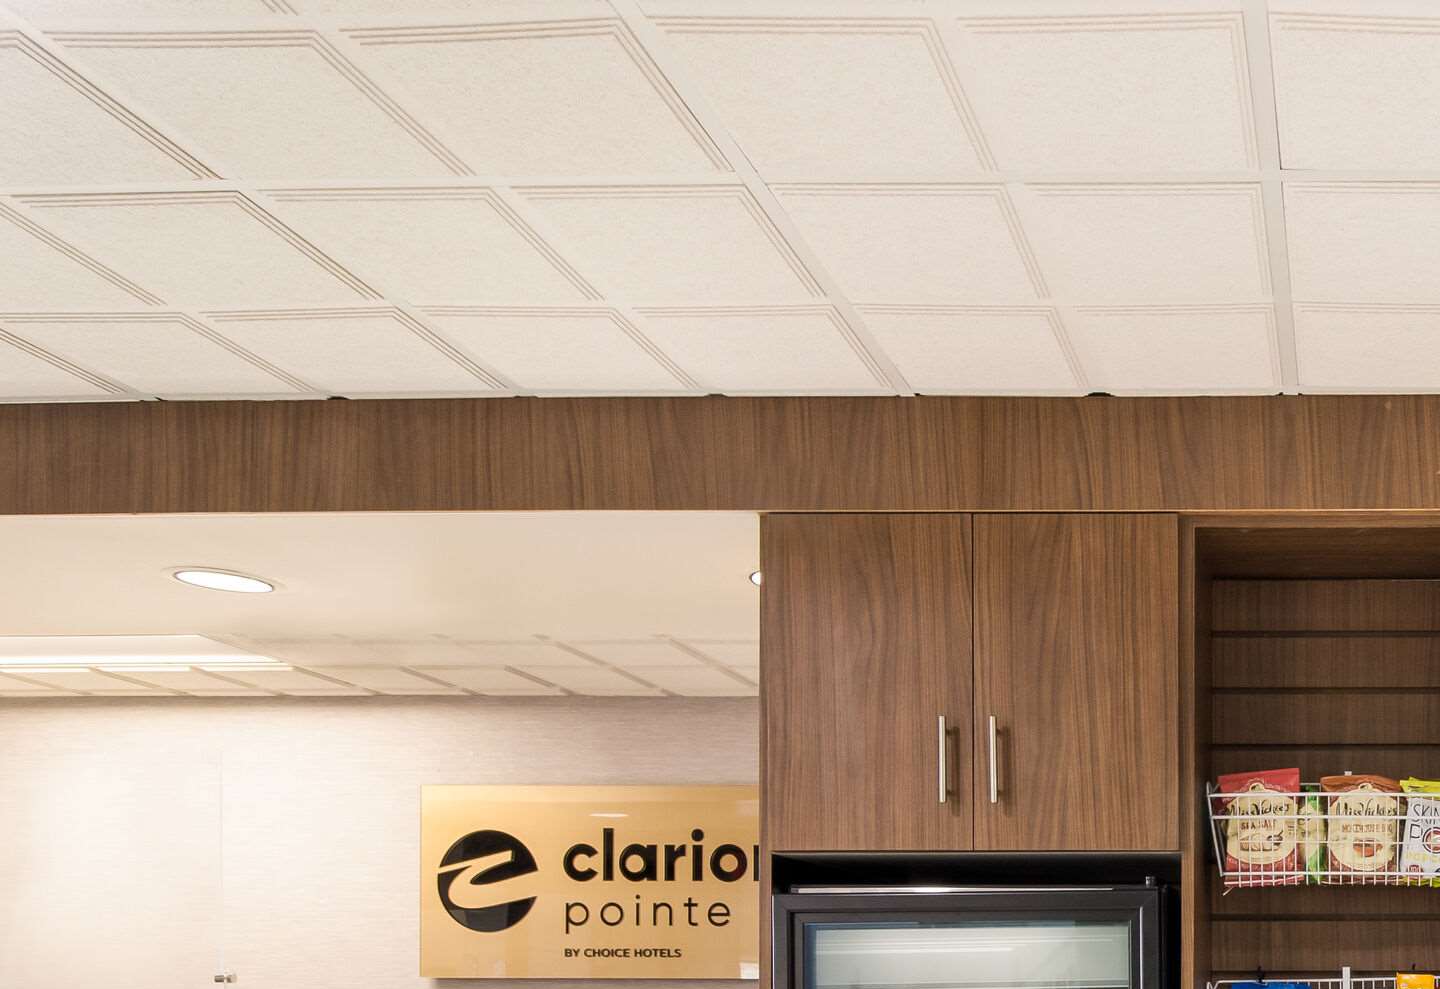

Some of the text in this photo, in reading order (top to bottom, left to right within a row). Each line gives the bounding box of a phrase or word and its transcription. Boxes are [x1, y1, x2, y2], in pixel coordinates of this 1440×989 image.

[564, 893, 732, 935] pointe
[564, 947, 682, 959] BY CHOICE HOTELS
